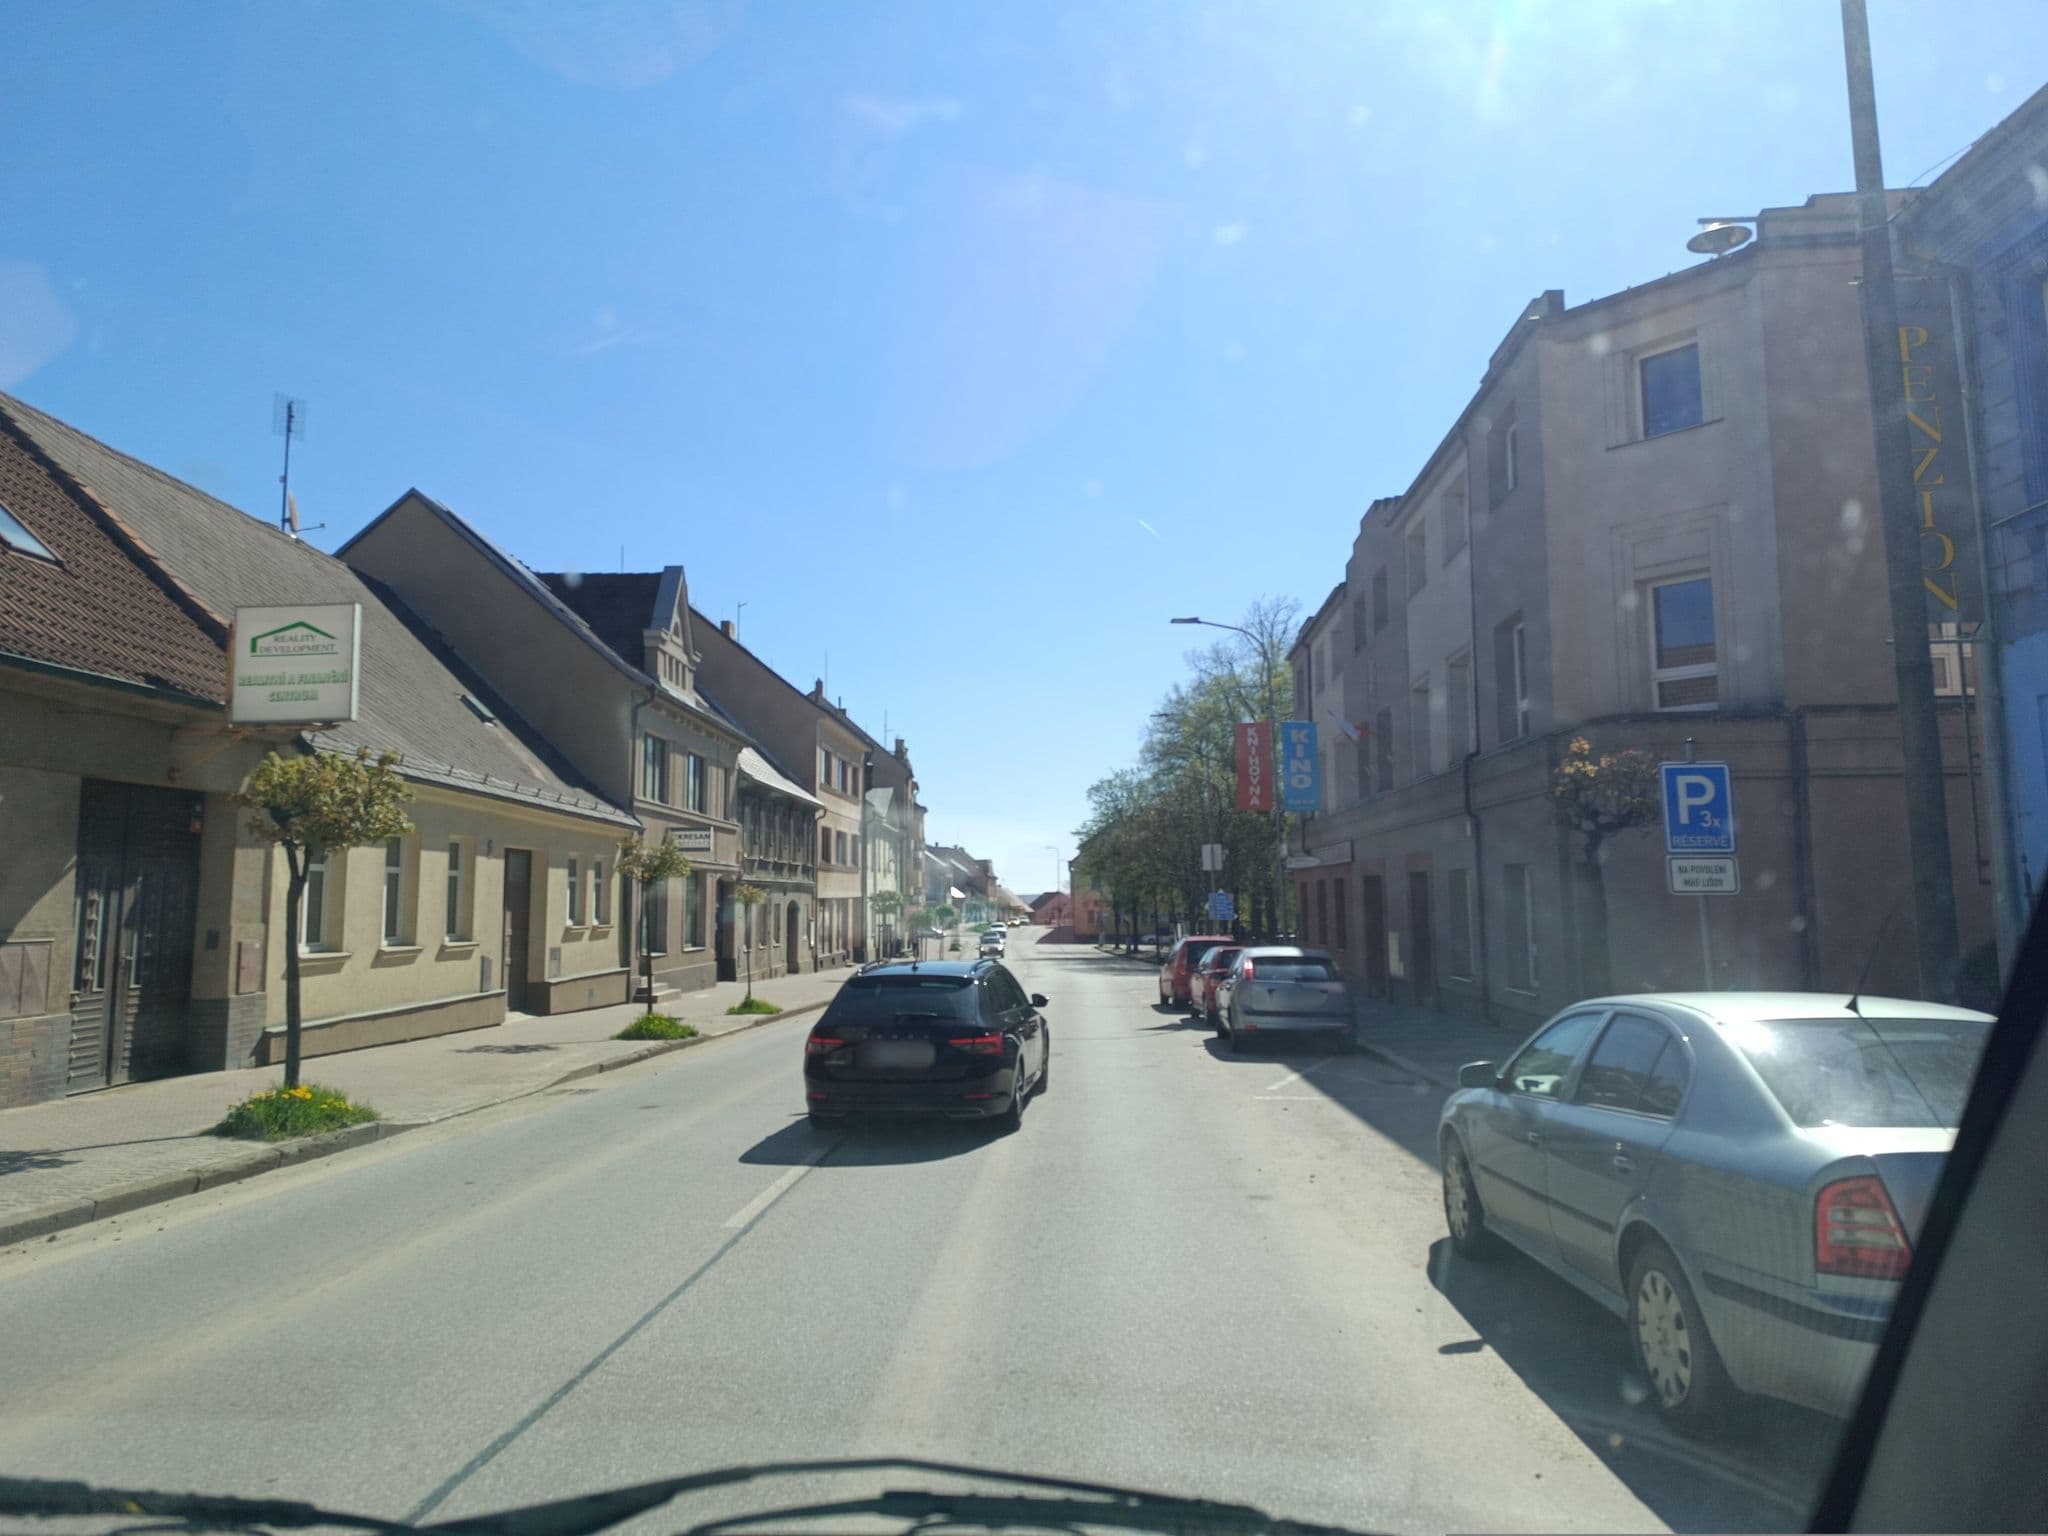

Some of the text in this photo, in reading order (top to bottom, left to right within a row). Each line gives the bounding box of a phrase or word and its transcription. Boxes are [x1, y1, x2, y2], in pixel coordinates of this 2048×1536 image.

[1899, 326, 1958, 611] PENZION
[259, 643, 336, 653] DEVELOPMENT
[273, 634, 317, 643] REALITY
[1247, 727, 1261, 806] KNIHOVNA
[1290, 729, 1313, 789] KINO
[1676, 775, 1715, 825] P
[1700, 810, 1721, 828] 3x
